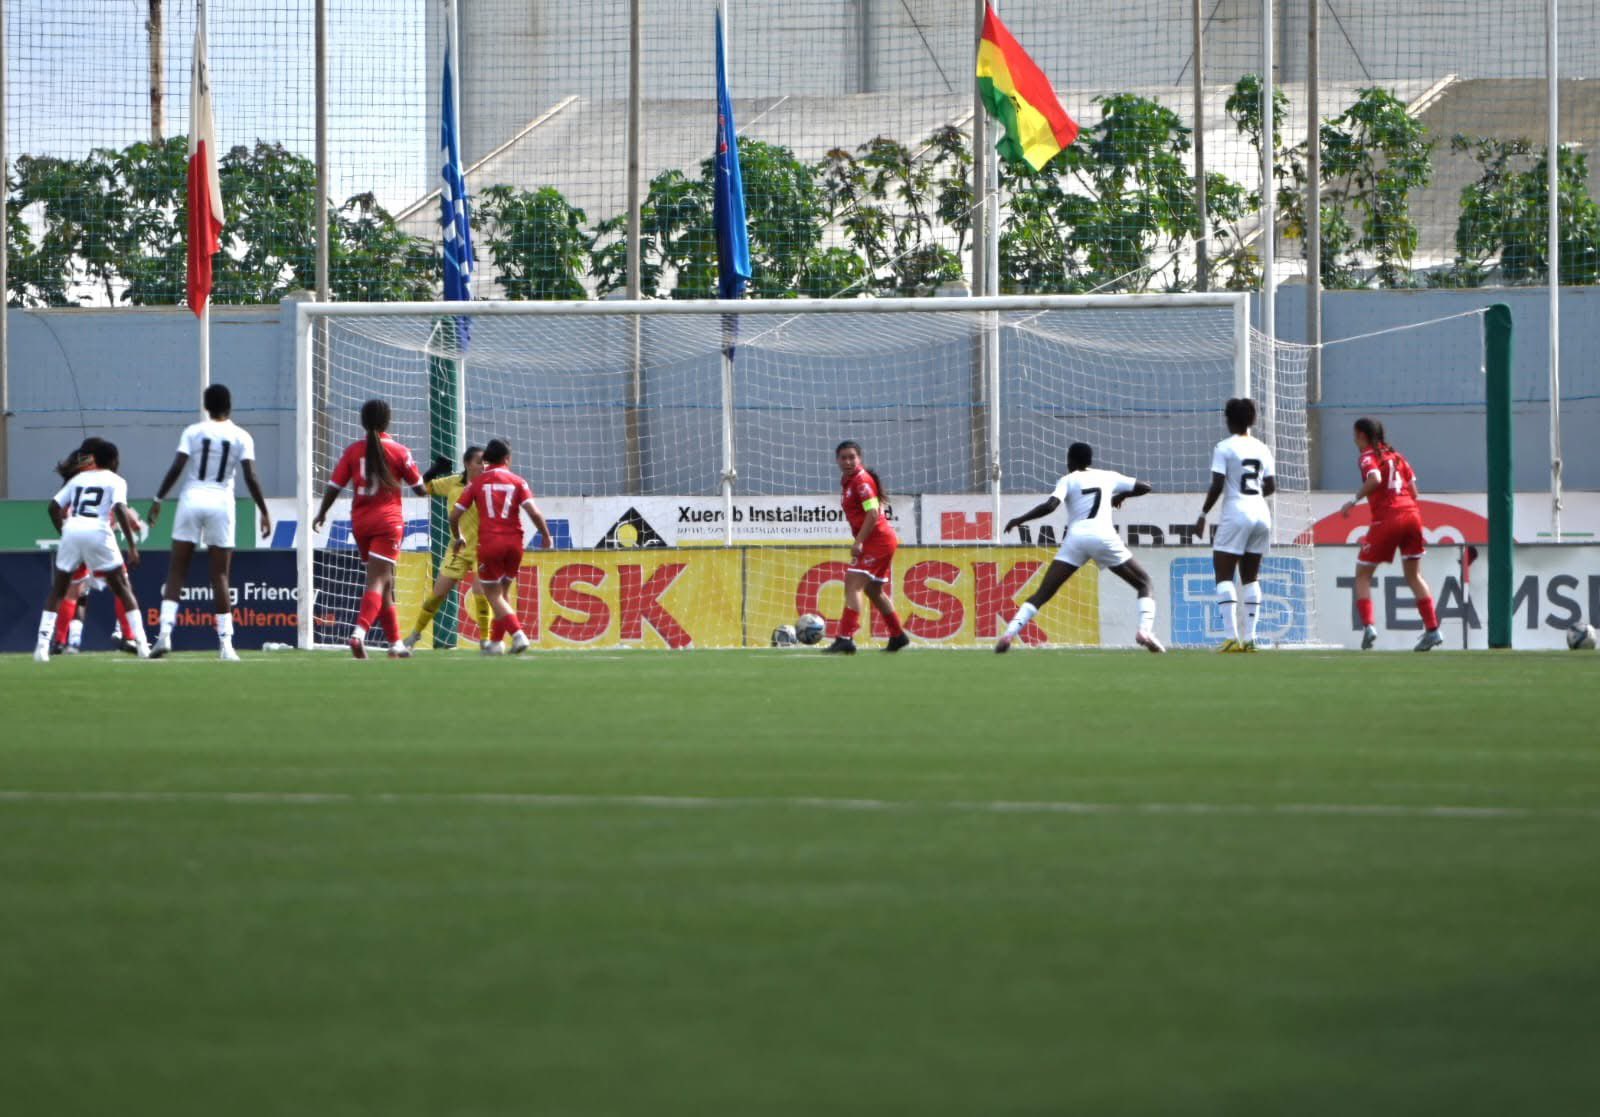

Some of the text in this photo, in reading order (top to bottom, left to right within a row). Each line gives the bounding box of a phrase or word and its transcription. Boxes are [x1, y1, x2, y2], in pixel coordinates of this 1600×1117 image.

[198, 438, 230, 483] 11
[1388, 459, 1403, 495] 4
[1240, 459, 1262, 496] 2
[72, 486, 104, 518] 12
[482, 484, 518, 519] 17
[678, 505, 743, 523] Xuerb
[1081, 487, 1102, 519] 7
[161, 582, 239, 605] amig
